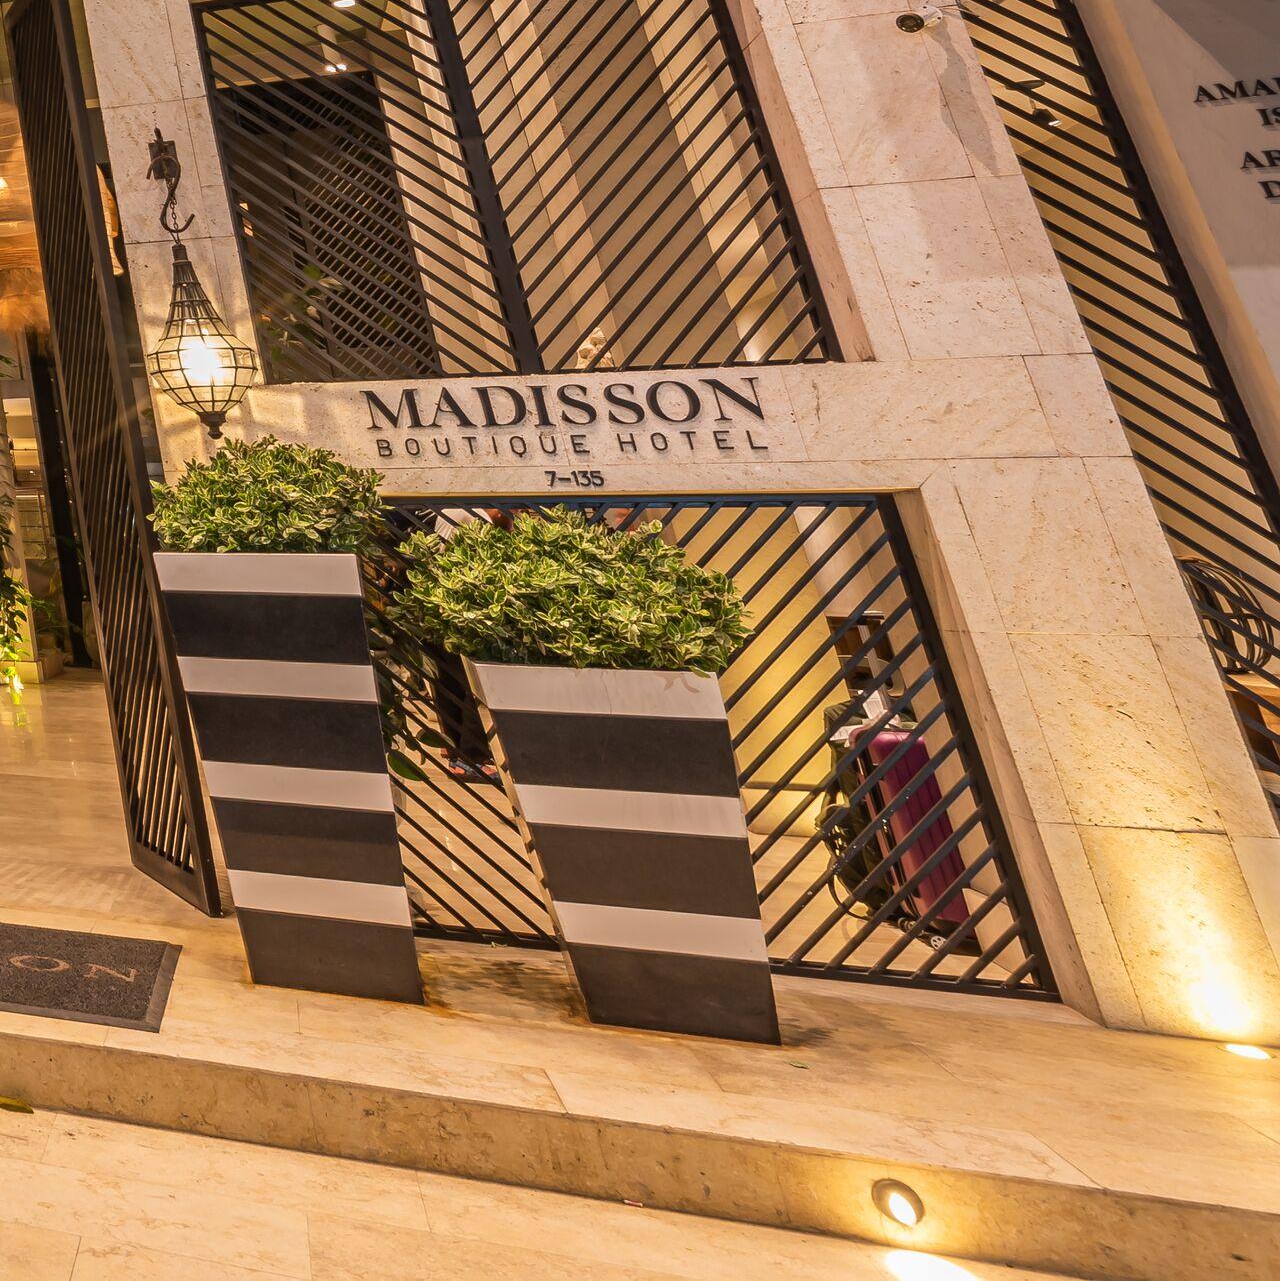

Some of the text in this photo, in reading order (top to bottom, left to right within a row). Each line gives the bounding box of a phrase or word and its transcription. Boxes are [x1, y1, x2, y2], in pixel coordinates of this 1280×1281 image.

[359, 376, 765, 430] MADISSON
[376, 430, 769, 457] BOUTIQUE HOTEL
[544, 470, 605, 488] 7-135
